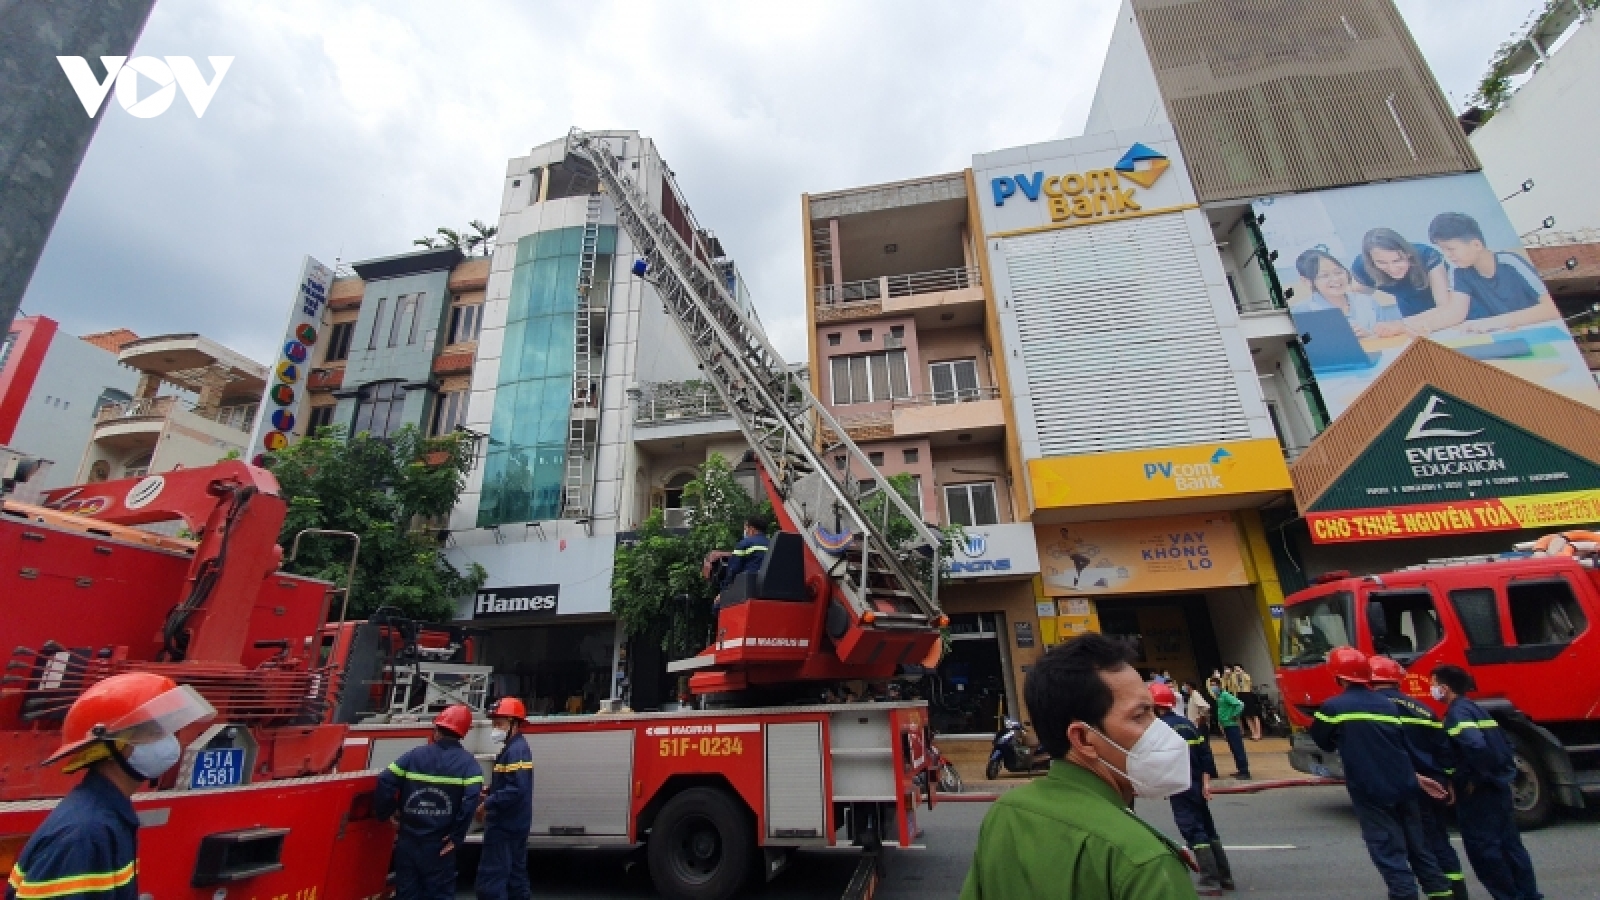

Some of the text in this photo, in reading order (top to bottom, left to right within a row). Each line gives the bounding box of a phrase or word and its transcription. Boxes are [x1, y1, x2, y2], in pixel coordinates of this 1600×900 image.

[991, 169, 1119, 207] PVcom
[1048, 187, 1142, 222] Bank
[1404, 442, 1496, 464] EVEREST
[1143, 461, 1213, 480] PVcom
[1411, 458, 1506, 477] EDUCATION
[1174, 475, 1225, 490] Bank
[1314, 517, 1351, 540] CHO
[1352, 509, 1402, 537] THUÊ
[1402, 505, 1475, 533] NGUYÊN
[1474, 501, 1513, 527] TÒA
[1167, 531, 1205, 544] VAY
[1141, 544, 1209, 560] KHÔNG
[475, 593, 557, 614] Hames
[659, 736, 743, 757] 51F-0234
[203, 750, 233, 769] 51A
[196, 767, 235, 787] 4581
